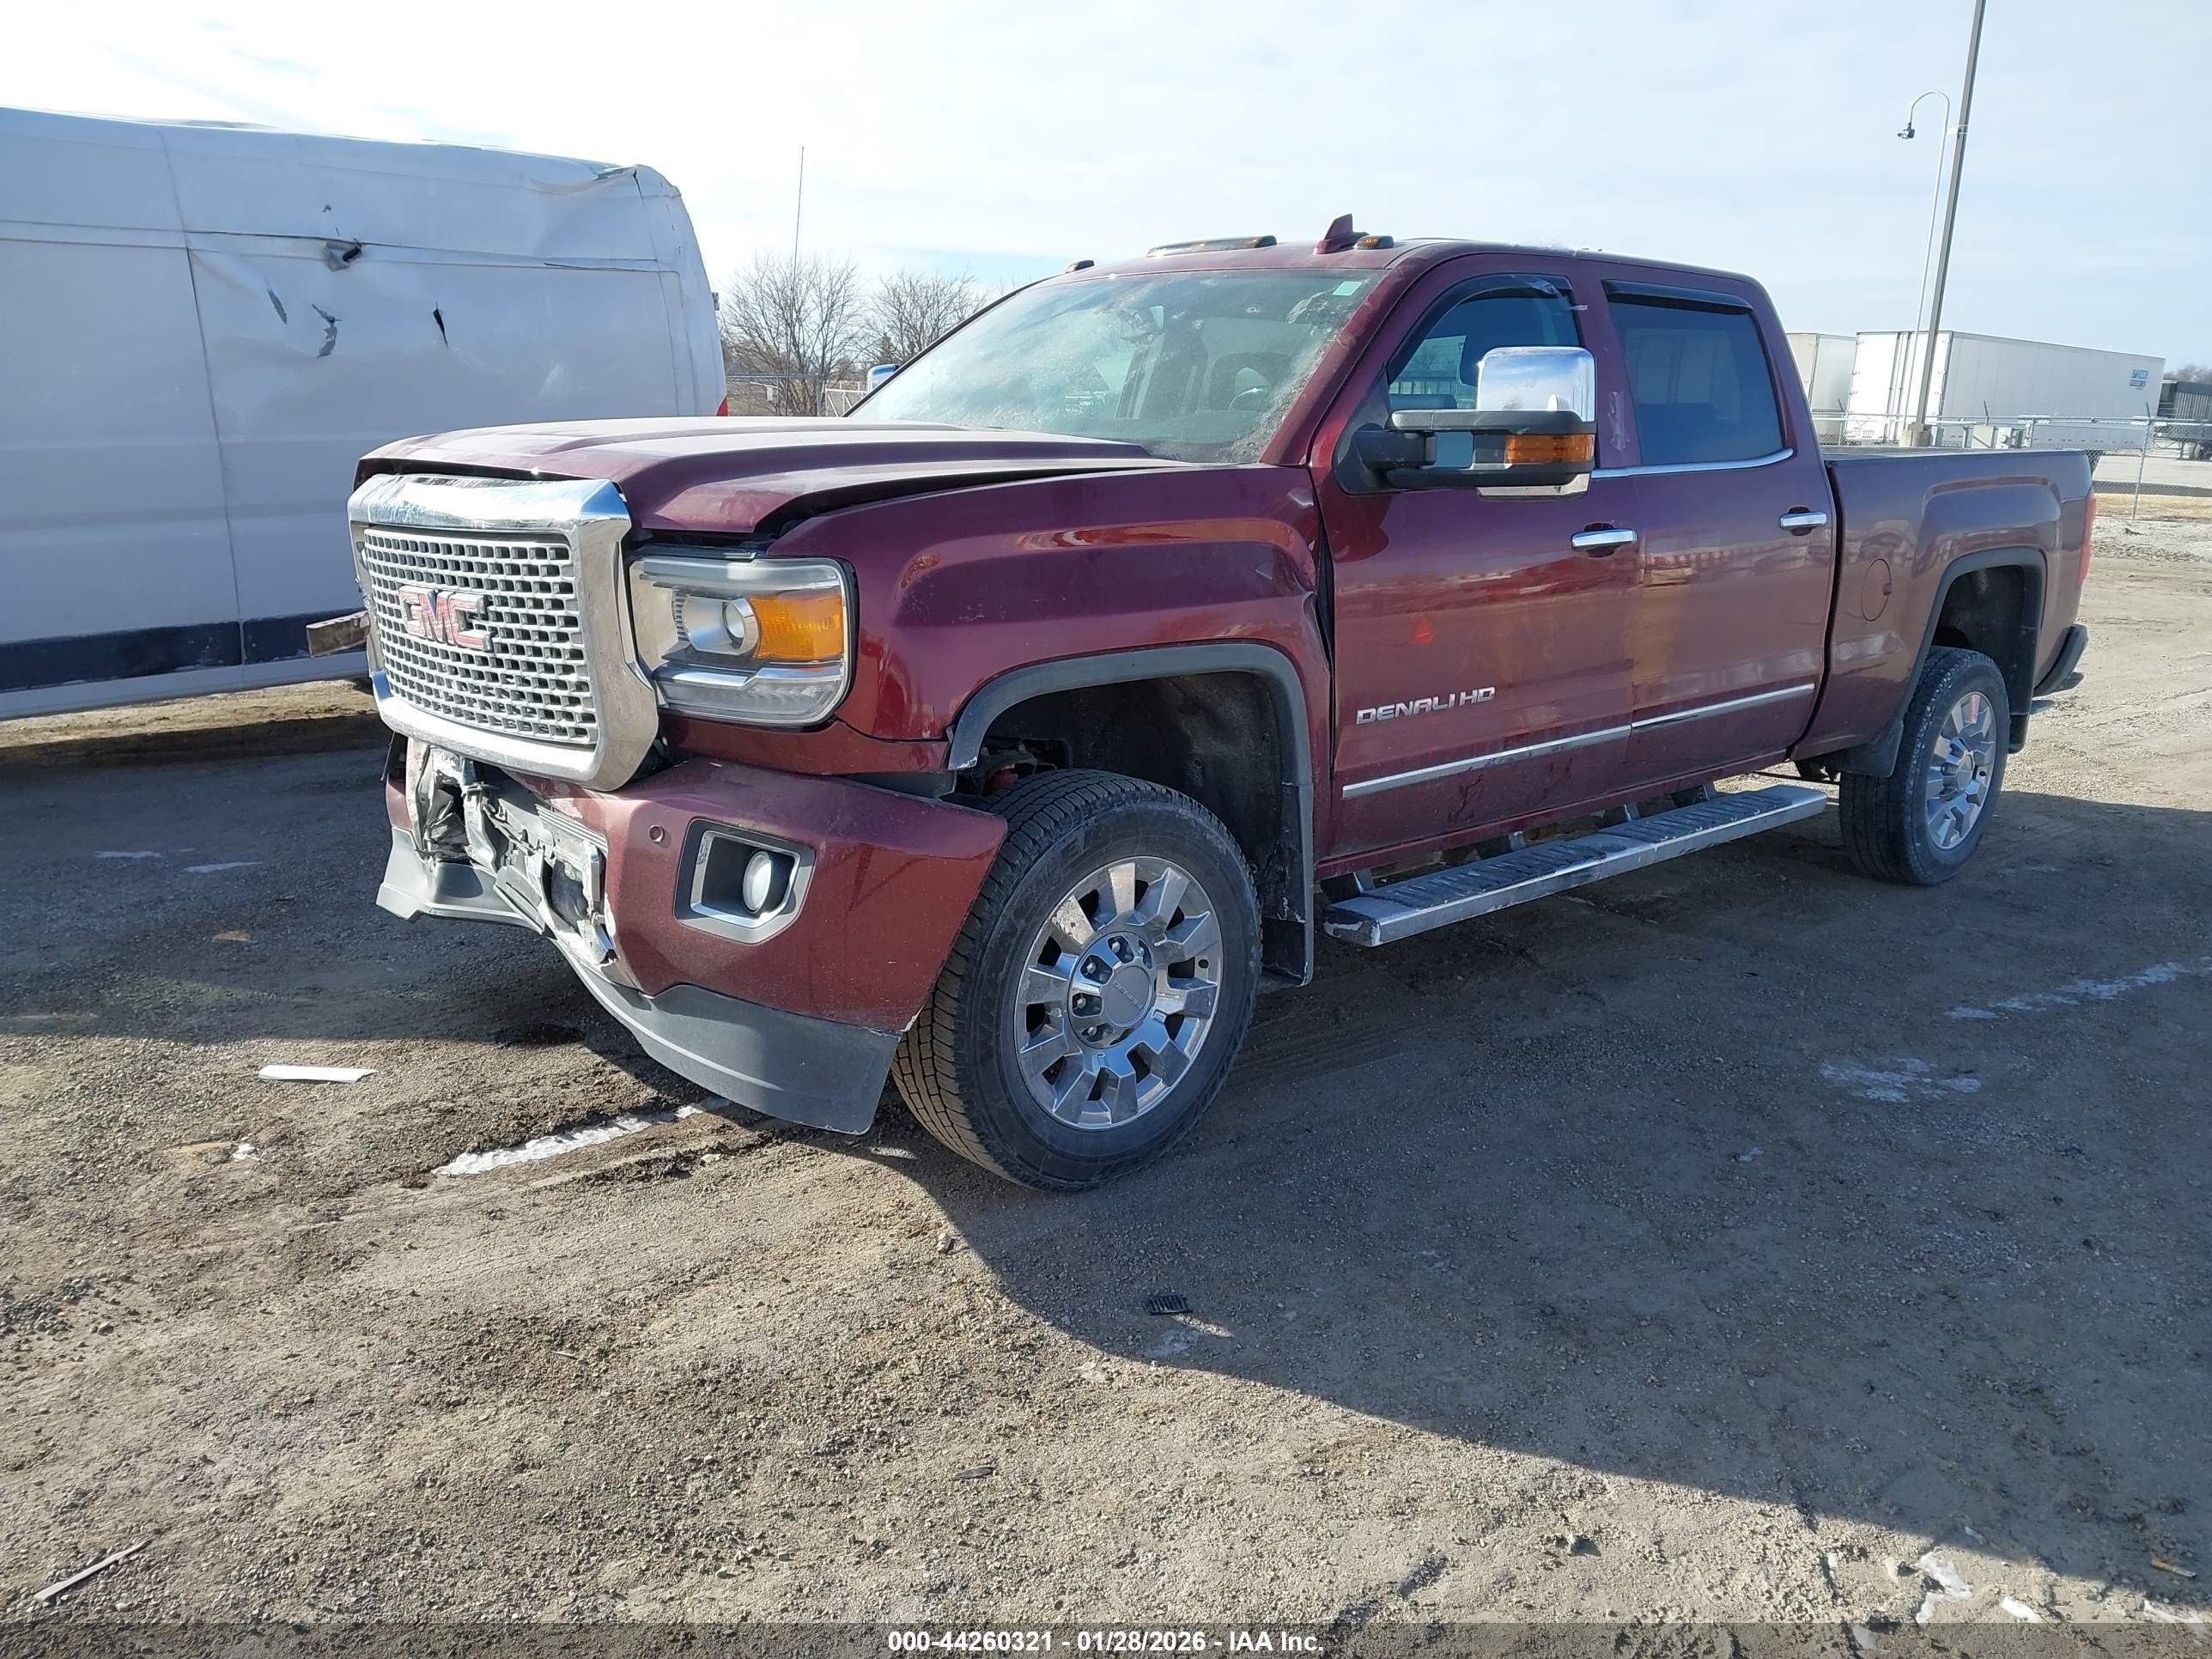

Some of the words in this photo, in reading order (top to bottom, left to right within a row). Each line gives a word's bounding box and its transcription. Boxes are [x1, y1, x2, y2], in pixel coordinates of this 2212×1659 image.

[398, 585, 493, 652] GMC
[1355, 693, 1455, 726] DENALI
[1459, 686, 1497, 707] HD
